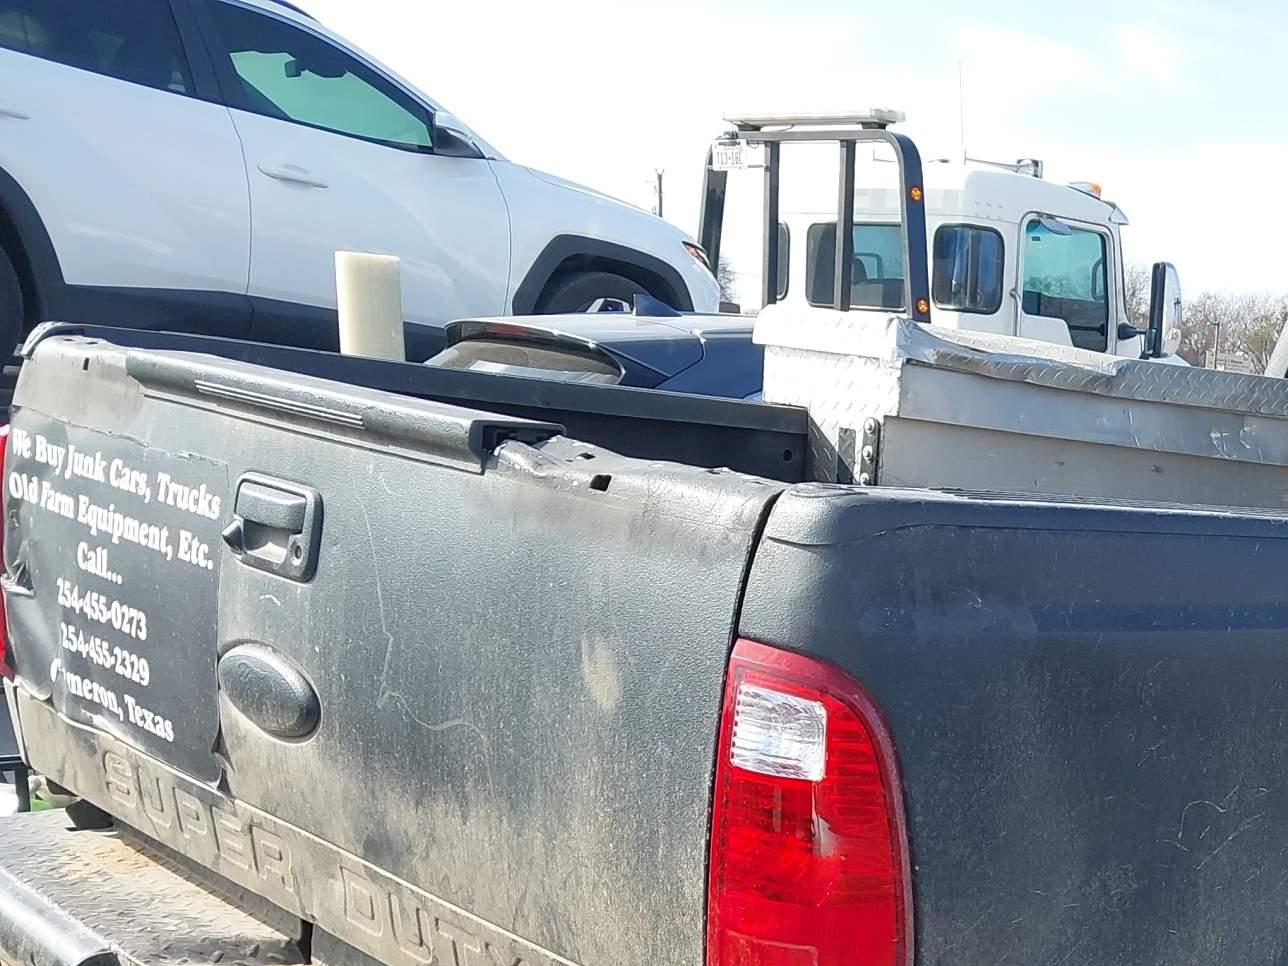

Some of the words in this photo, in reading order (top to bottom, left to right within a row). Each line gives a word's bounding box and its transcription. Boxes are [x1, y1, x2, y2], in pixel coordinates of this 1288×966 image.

[12, 427, 32, 459] We
[35, 434, 65, 476] Buy
[65, 444, 107, 483] Junk
[109, 458, 151, 503] Cars,
[156, 473, 221, 520] Trucks
[9, 472, 38, 504] Old
[40, 480, 75, 520] Farm
[77, 494, 173, 562] Equipment,
[178, 529, 213, 570] Etc.
[56, 578, 147, 641] 254-455-0273
[61, 622, 150, 687] 254-455-2329
[123, 693, 174, 743] Texas
[102, 750, 297, 893] SUPER
